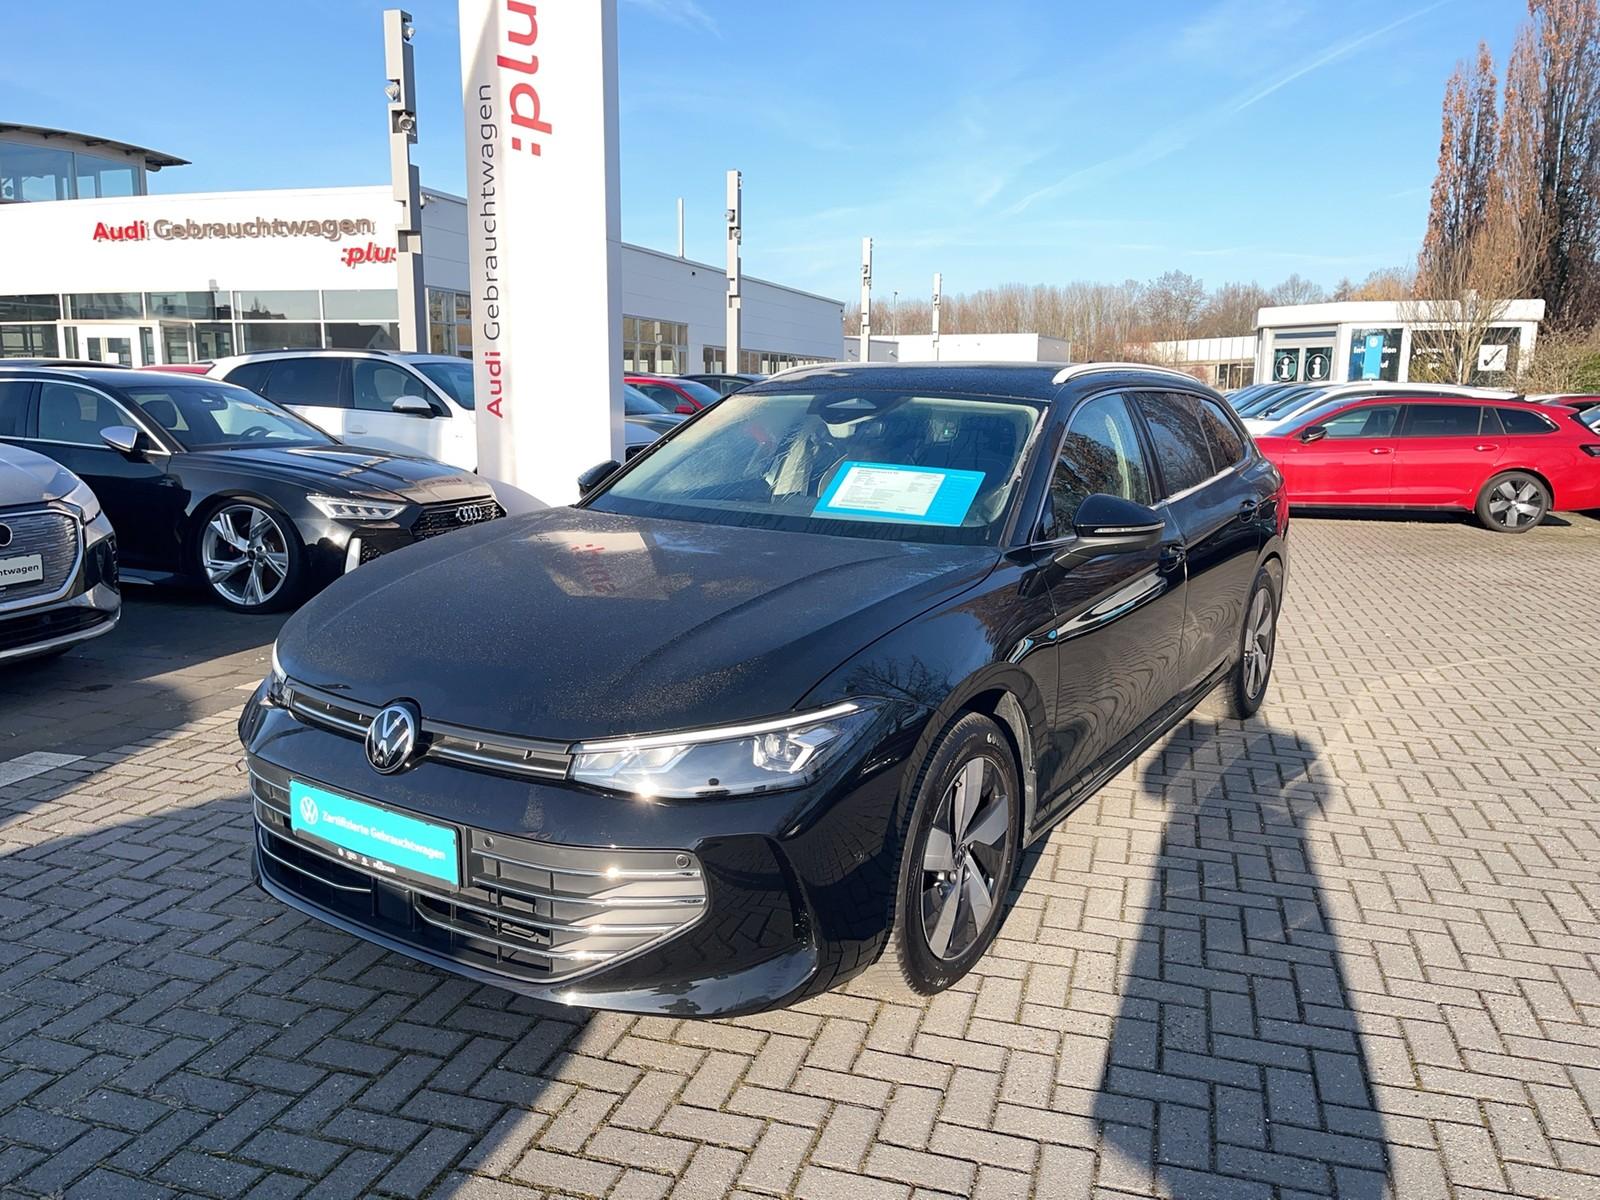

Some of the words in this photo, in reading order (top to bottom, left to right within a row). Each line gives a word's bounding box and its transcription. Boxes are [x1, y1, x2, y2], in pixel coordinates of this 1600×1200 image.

[93, 221, 146, 242] Audi
[153, 217, 376, 241] Gebrauchtwagen
[477, 84, 501, 341] Gebrauchtwagen
[485, 350, 504, 419] Audi
[371, 827, 446, 859] Gebrauchtwagen
